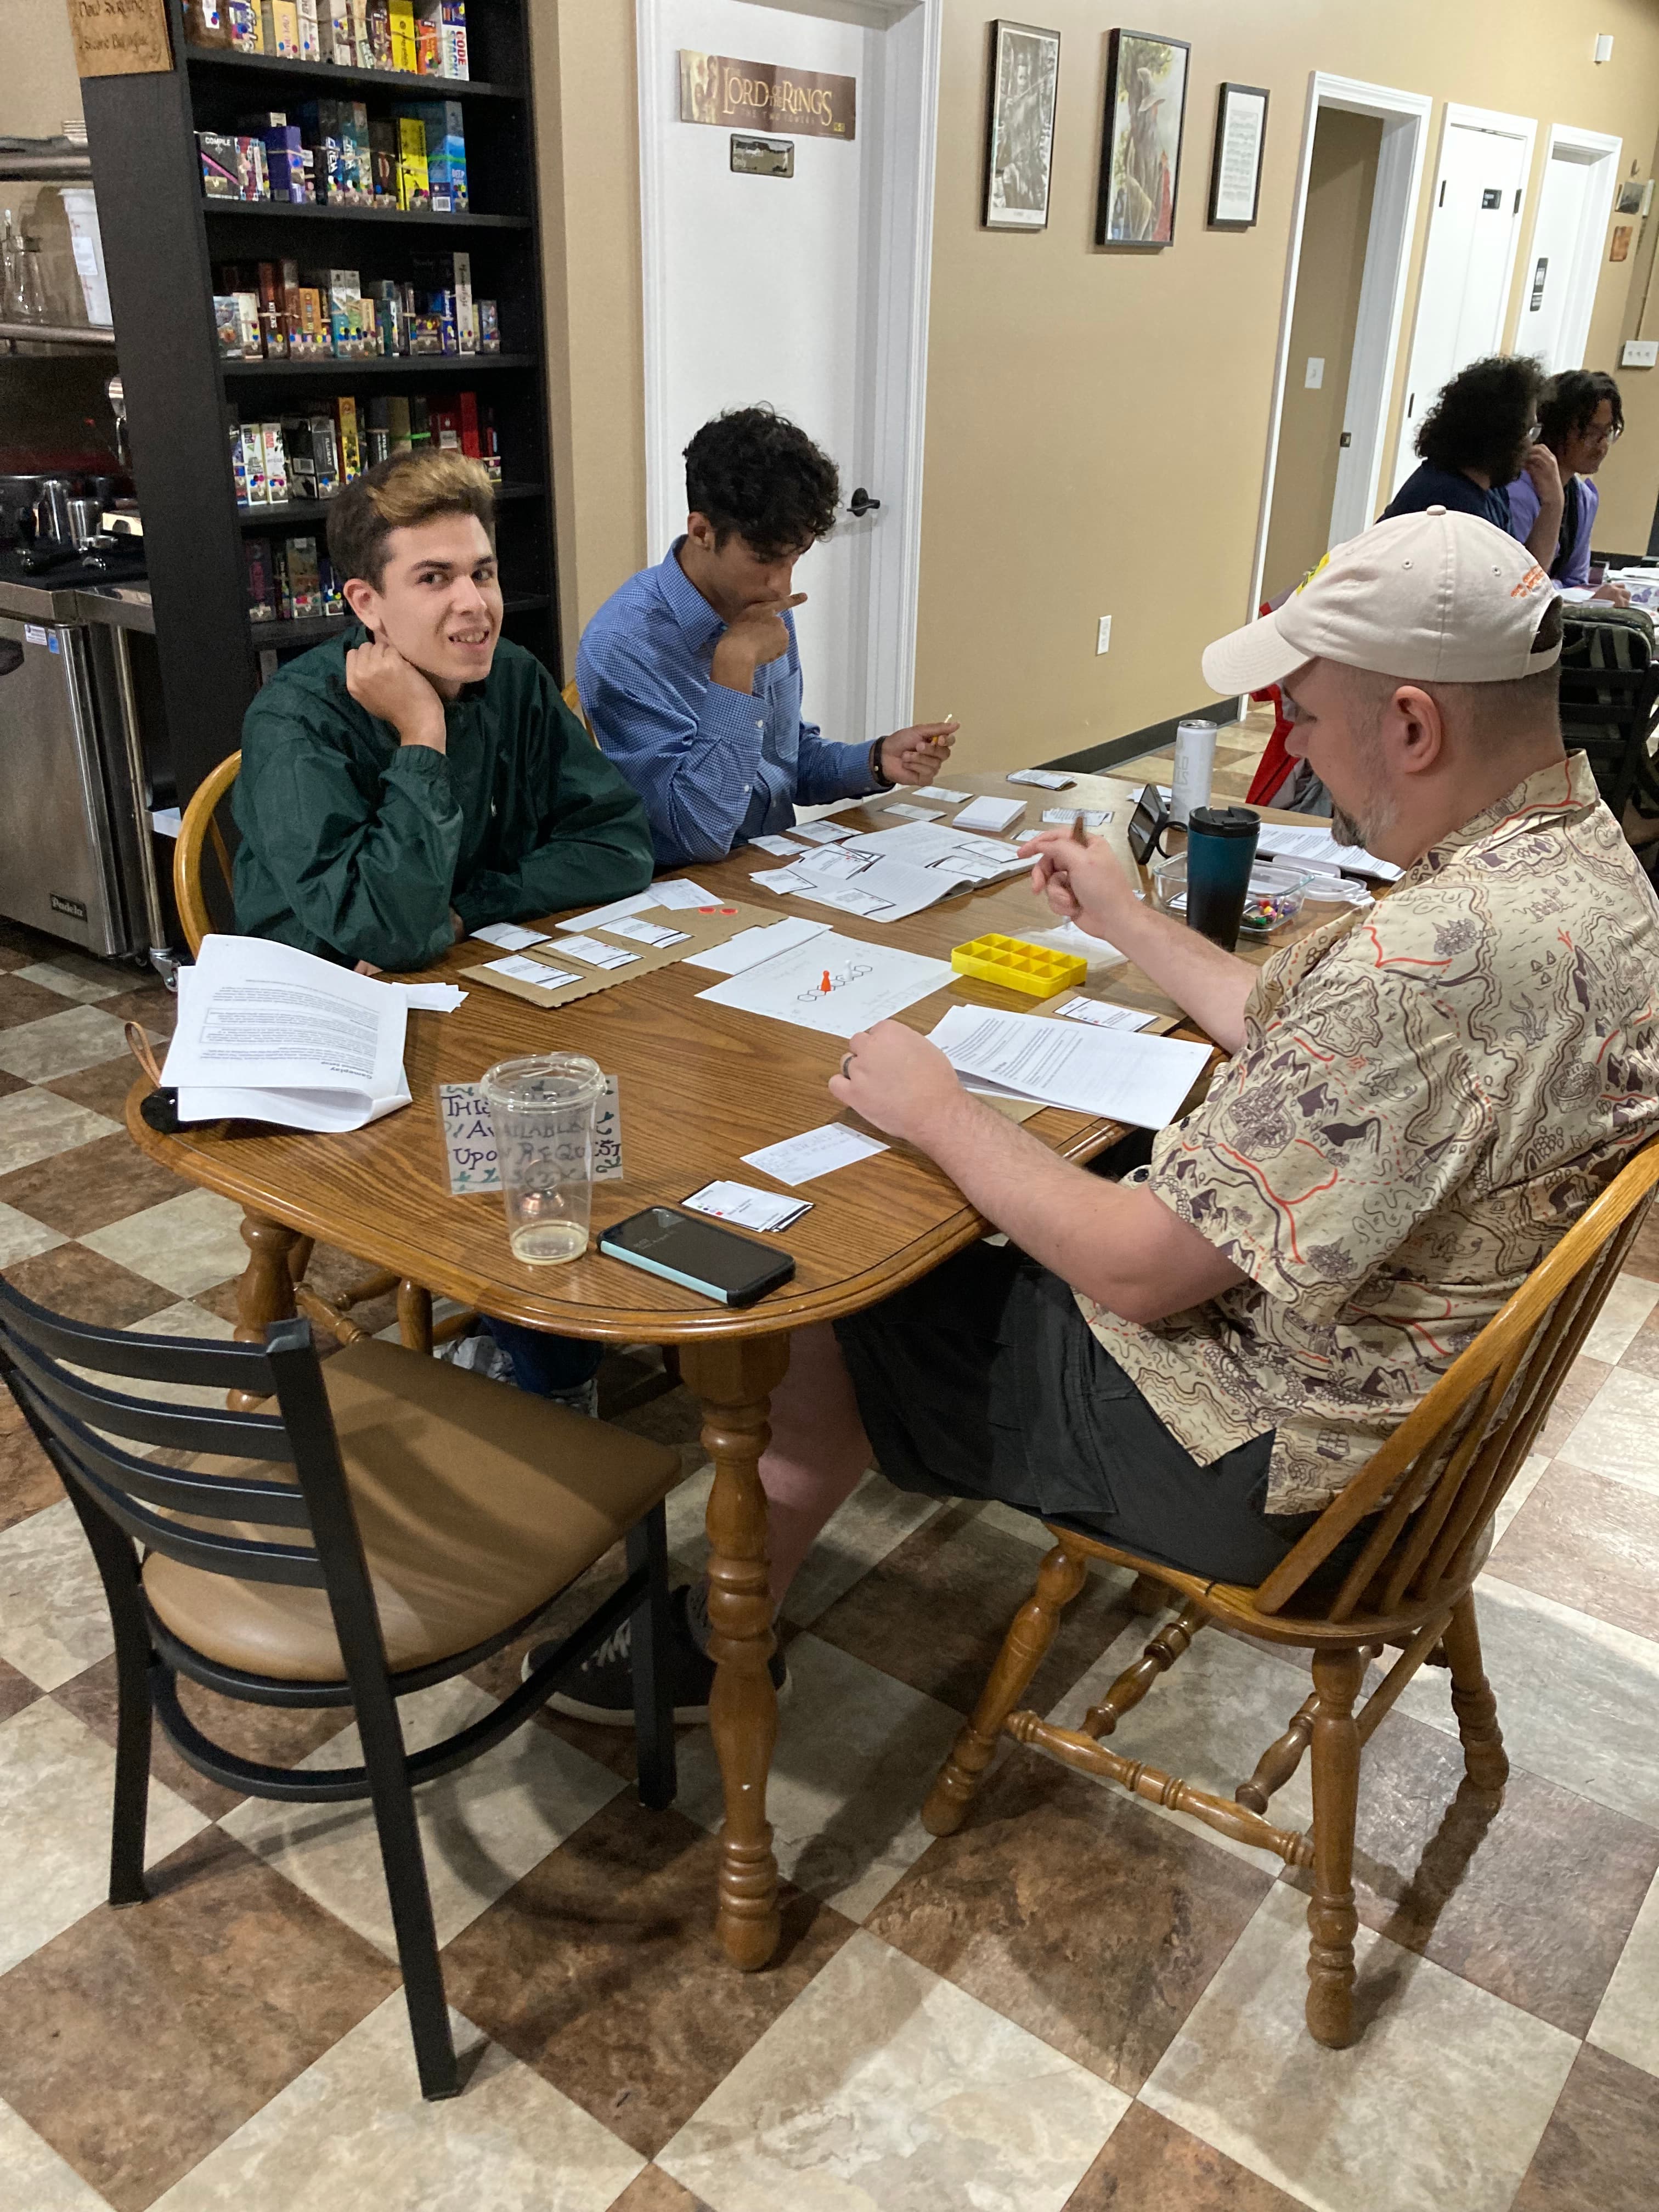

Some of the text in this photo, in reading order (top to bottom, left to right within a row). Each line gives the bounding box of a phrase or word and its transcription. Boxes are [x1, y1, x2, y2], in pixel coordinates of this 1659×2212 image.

[456, 31, 466, 65] CODE
[723, 67, 769, 114] LORD
[781, 80, 832, 126] RINGS
[205, 137, 230, 146] COMPILE
[330, 1067, 373, 1079] Gameplay
